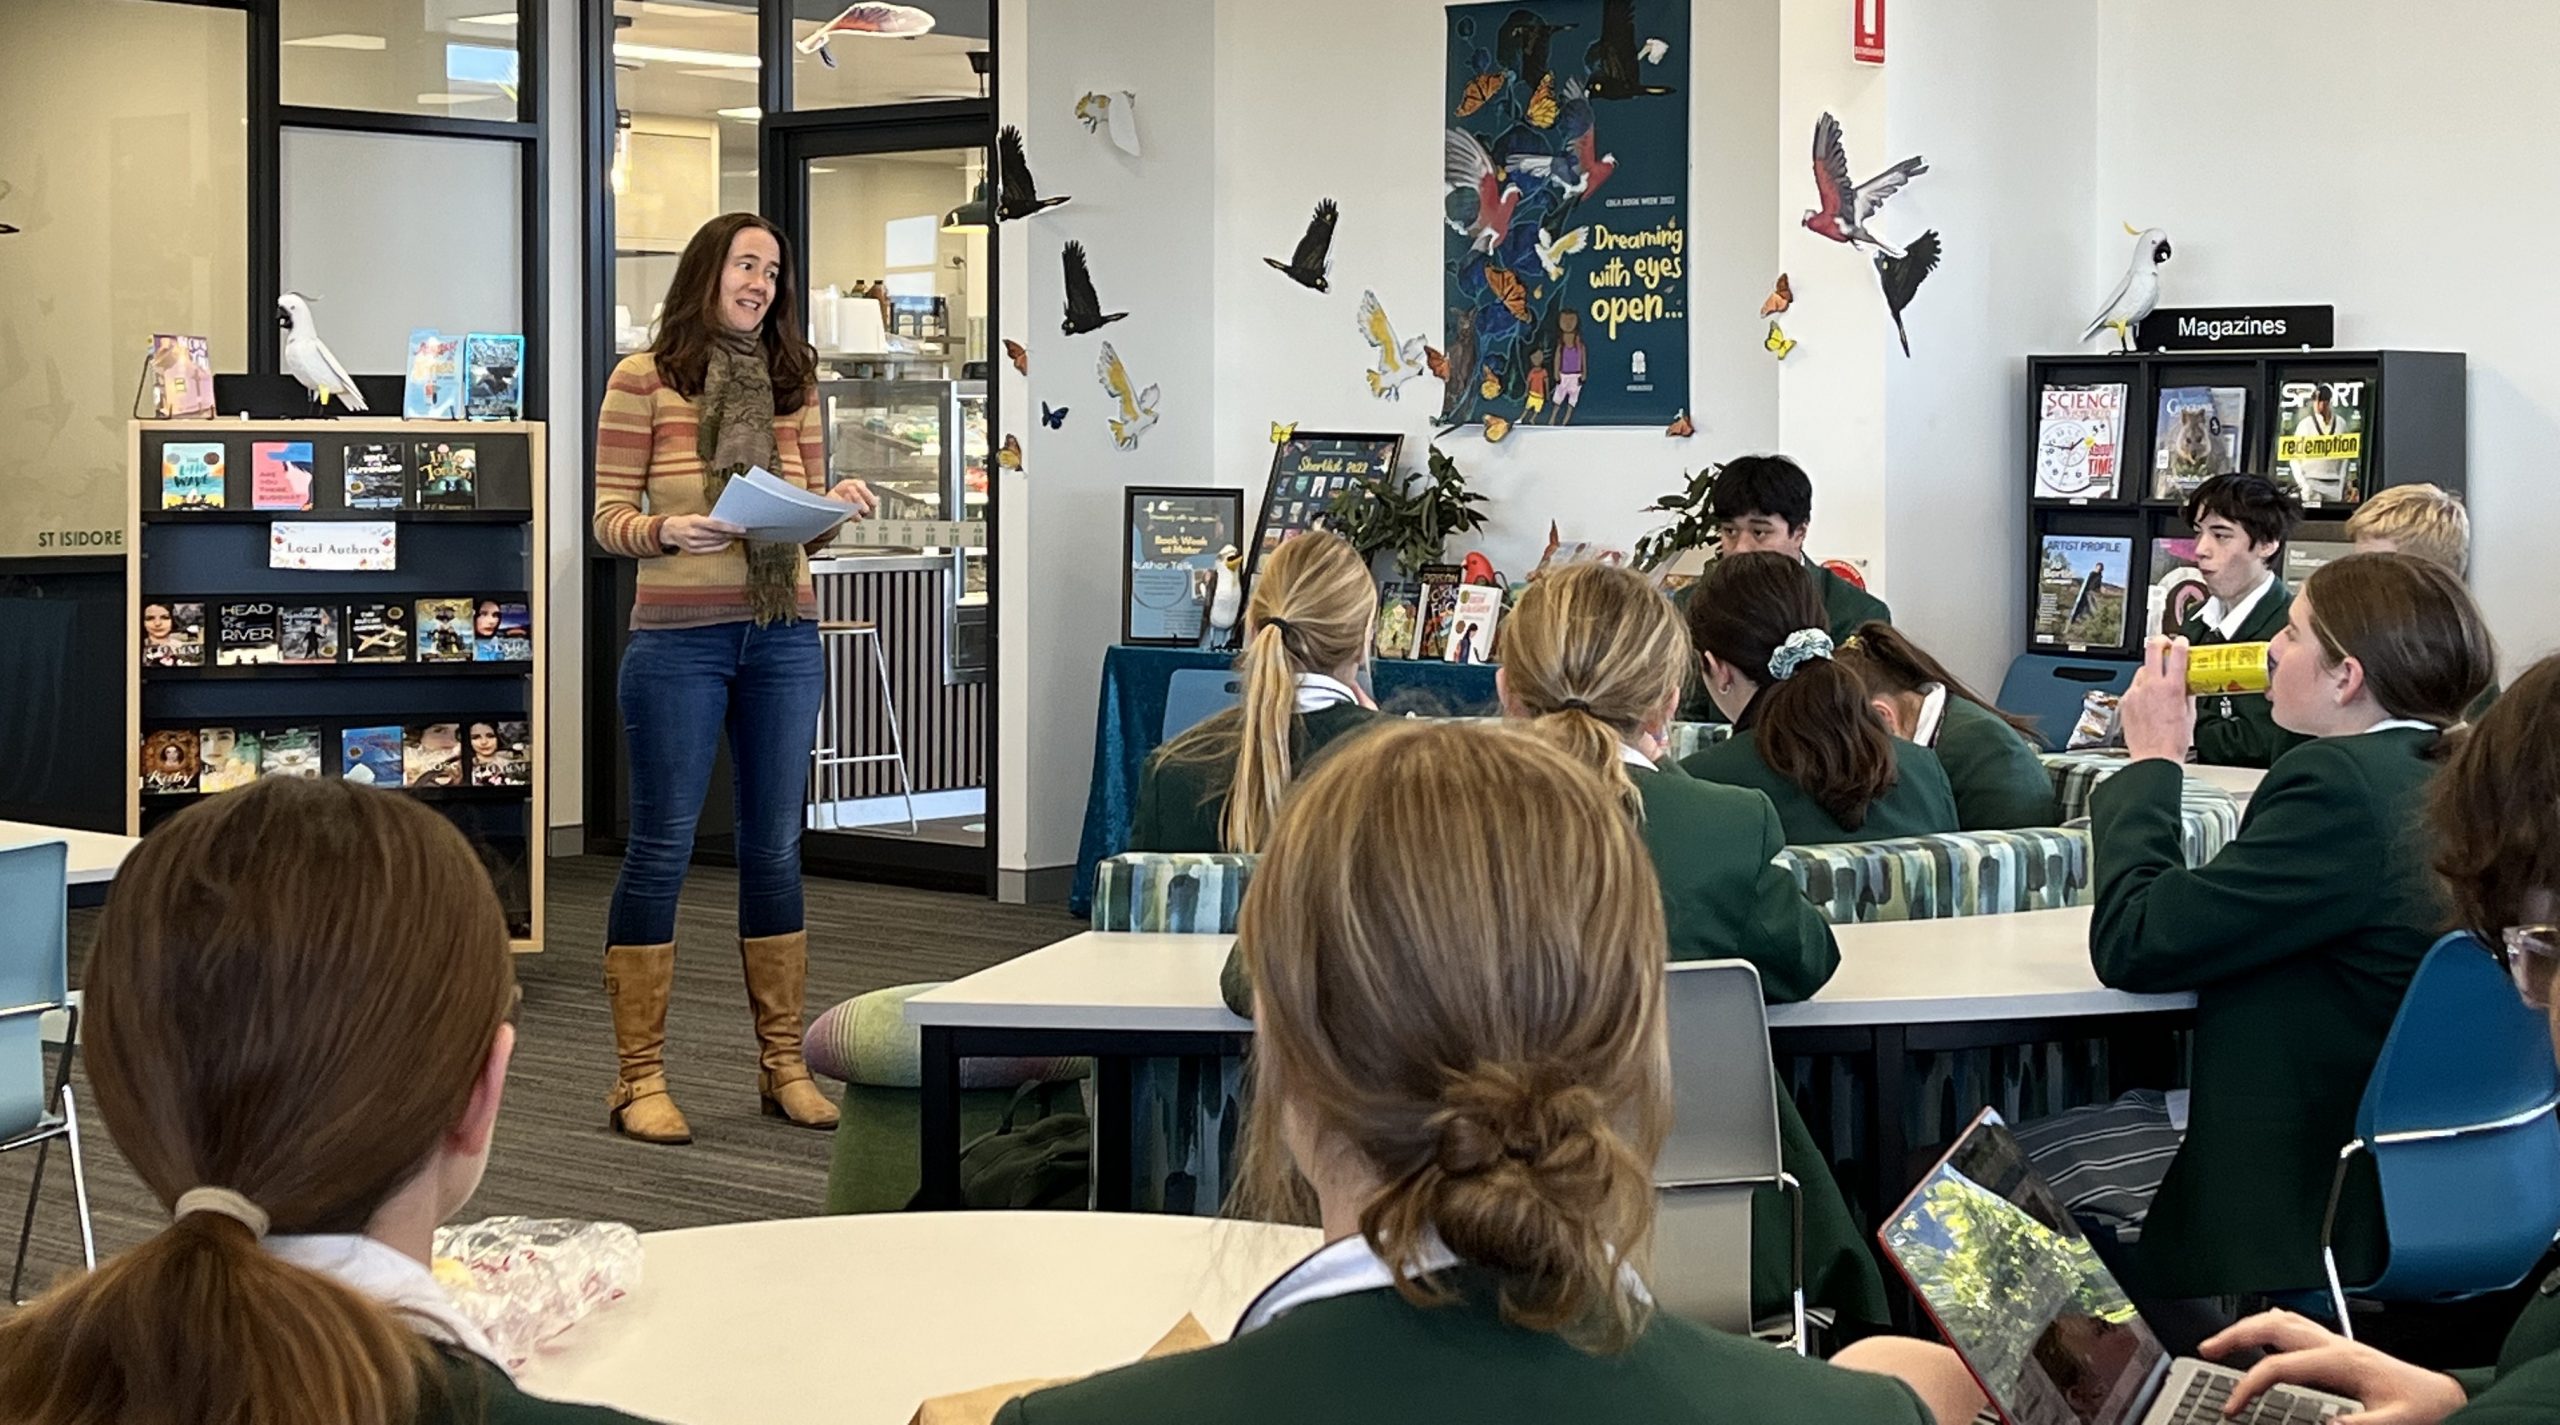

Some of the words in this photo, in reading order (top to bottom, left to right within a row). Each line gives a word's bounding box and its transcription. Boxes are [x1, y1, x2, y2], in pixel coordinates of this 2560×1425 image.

[1593, 224, 1683, 254] Dreaming
[1589, 256, 1631, 288] with
[1634, 256, 1682, 289] eyes
[1590, 293, 1683, 340] open...
[2178, 315, 2287, 341] Magazines
[2047, 393, 2118, 409] SCIENCE
[2281, 437, 2357, 456] redemption
[1298, 456, 1343, 473] Shortlist
[2088, 459, 2114, 476] TIME
[38, 532, 55, 547] ST
[60, 530, 122, 547] ISIDORE
[2047, 541, 2079, 551] ARTIST
[2080, 541, 2122, 553] PROFILE
[287, 542, 322, 554] Local
[327, 543, 380, 555] Authors
[221, 603, 274, 616] HEAD
[222, 628, 275, 642] RIVER
[149, 770, 194, 786] Ruby
